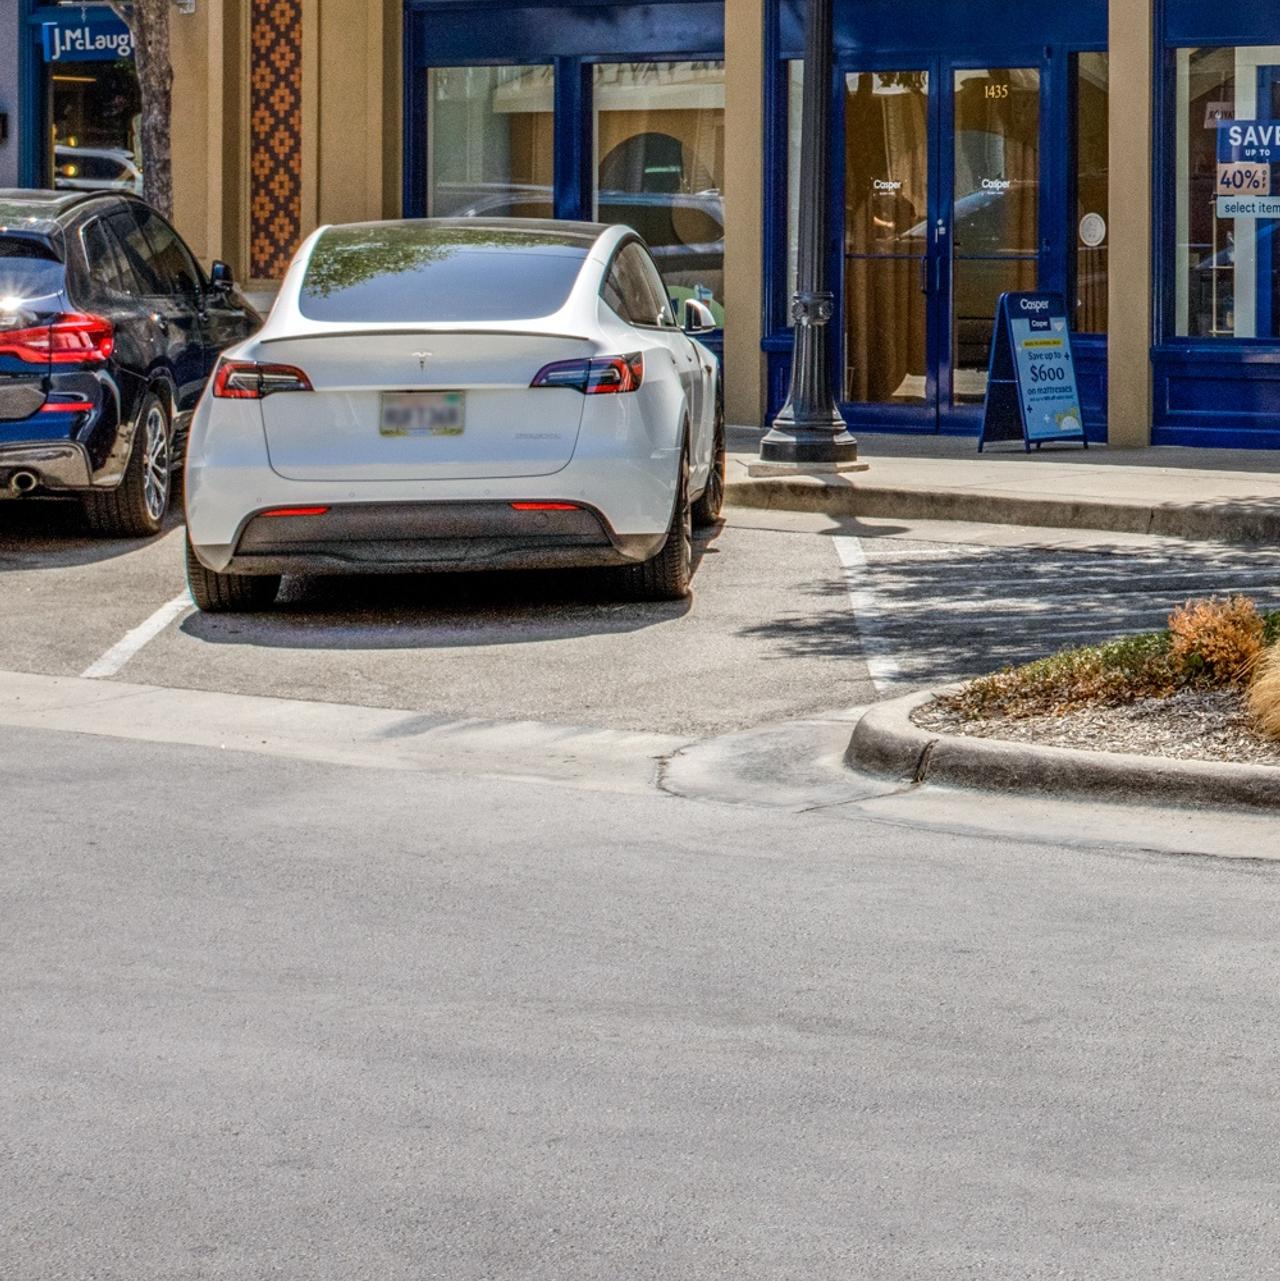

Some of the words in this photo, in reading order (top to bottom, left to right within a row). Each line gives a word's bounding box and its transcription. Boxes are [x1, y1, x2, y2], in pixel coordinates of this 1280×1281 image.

[984, 84, 1008, 99] 1435
[1245, 149, 1256, 157] UP
[1260, 149, 1271, 157] TO
[873, 179, 901, 191] Casper
[981, 178, 1010, 190] Casper
[1220, 169, 1260, 189] 40%
[1225, 202, 1256, 213] select
[1020, 298, 1049, 313] Casper
[1028, 351, 1043, 360] Save
[1030, 364, 1065, 382] $600
